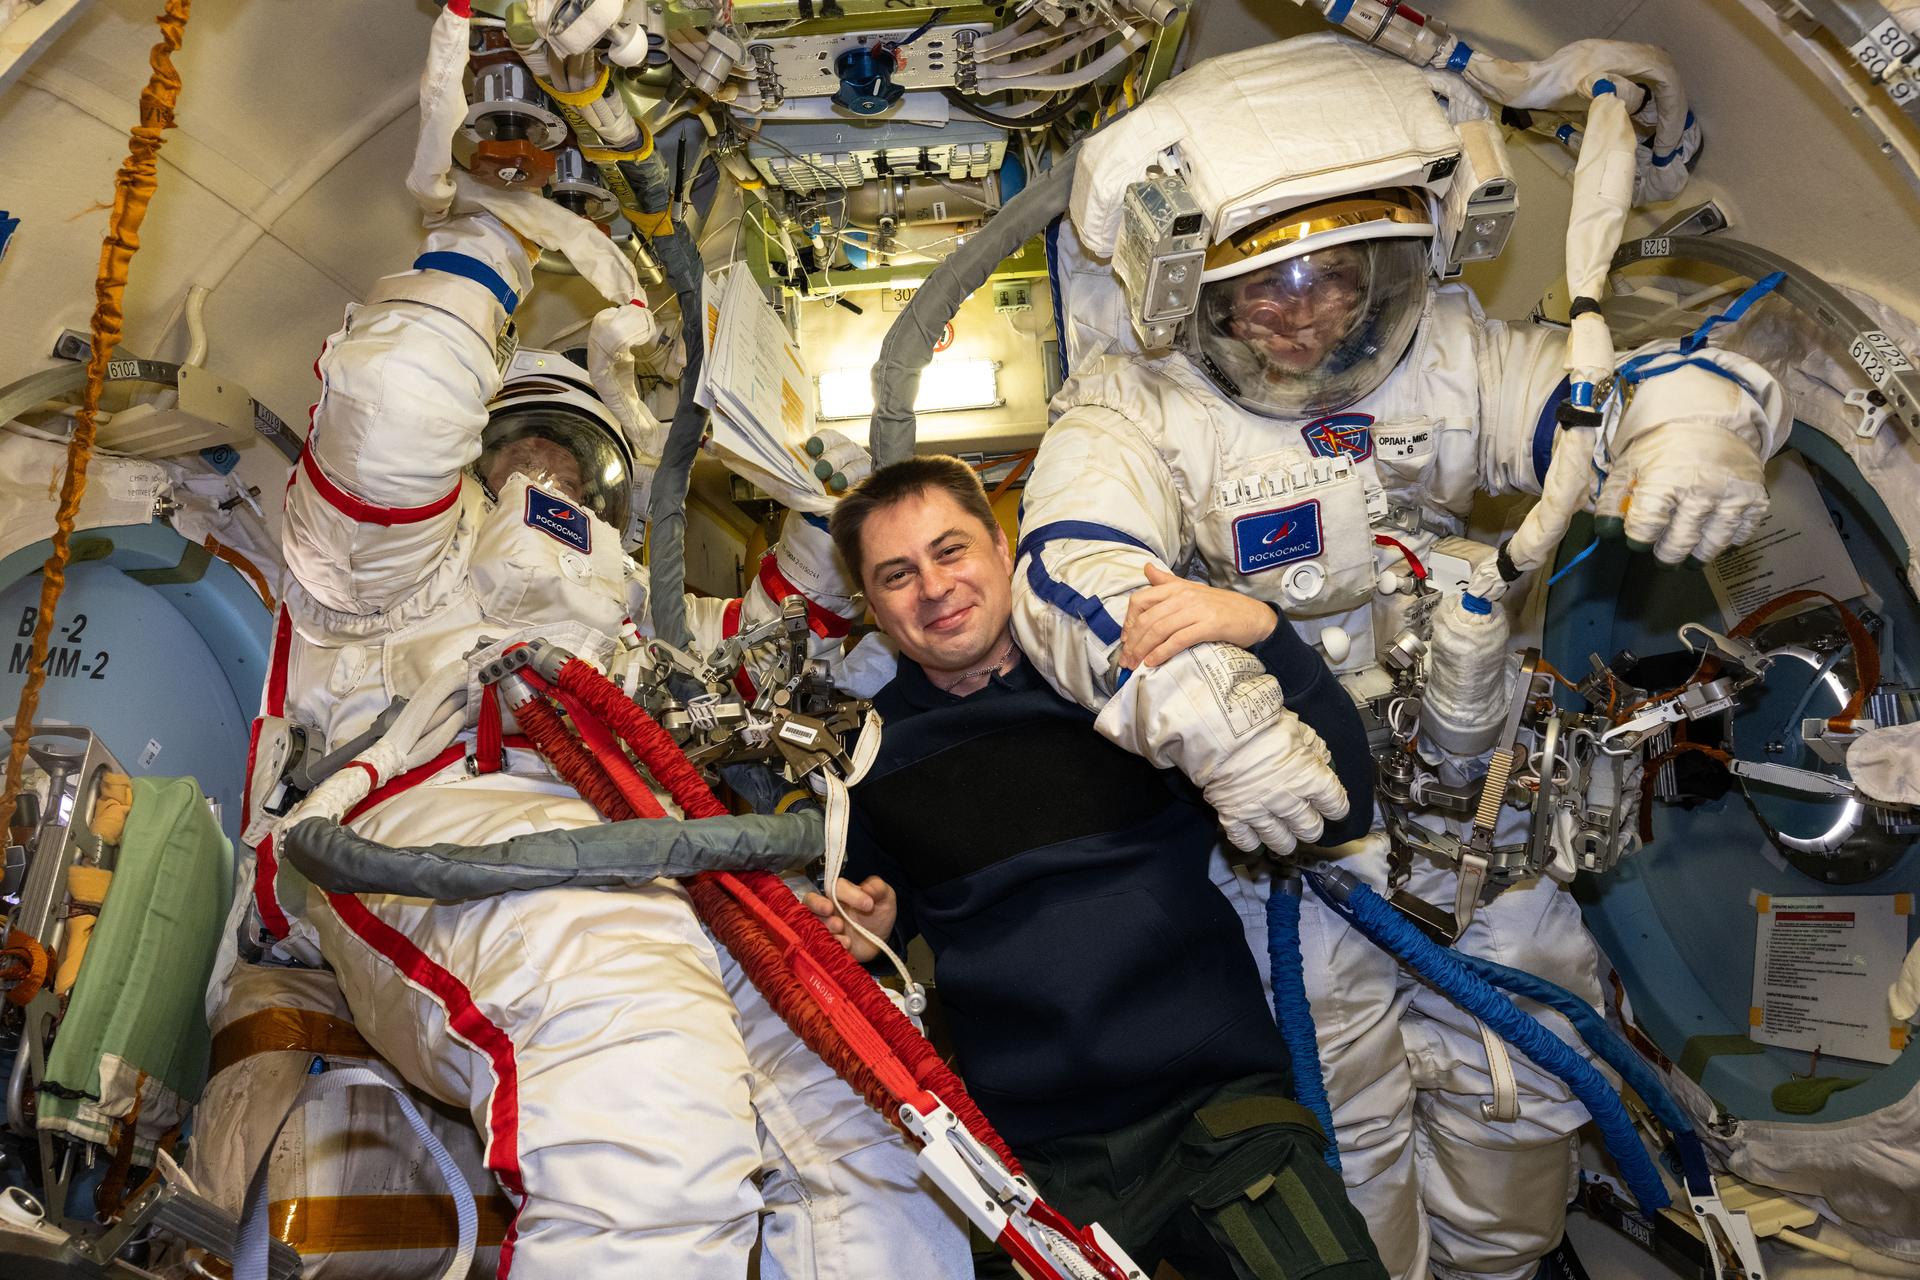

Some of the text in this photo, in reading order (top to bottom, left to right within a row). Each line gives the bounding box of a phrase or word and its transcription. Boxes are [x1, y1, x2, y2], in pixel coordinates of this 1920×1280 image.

[1859, 46, 1909, 98] 608
[1644, 240, 1668, 255] 6123
[1853, 341, 1885, 383] 6123
[1867, 334, 1907, 366] 6123
[110, 361, 137, 378] 6102
[1379, 436, 1407, 446] ОРЛАН
[1412, 432, 1428, 443] МКС
[1406, 444, 1414, 454] 6
[536, 514, 584, 544] РОСКОСМОС
[1248, 541, 1312, 563] РОСКОСМОС
[17, 606, 88, 643] В-2
